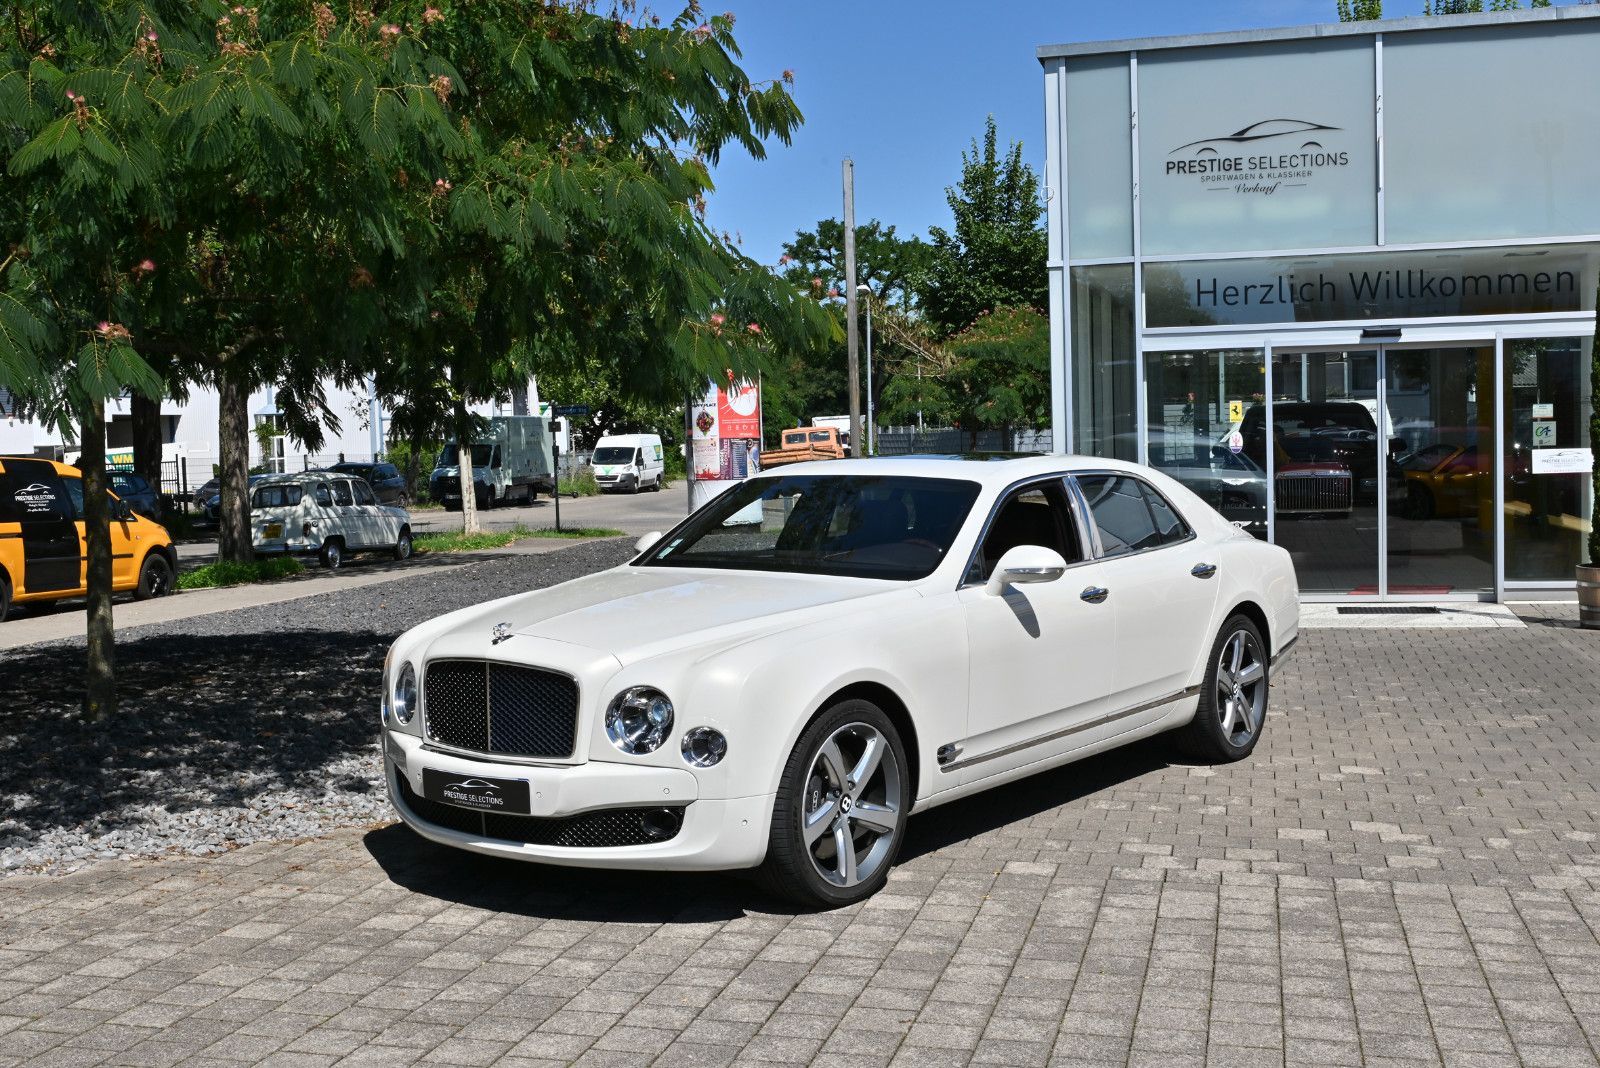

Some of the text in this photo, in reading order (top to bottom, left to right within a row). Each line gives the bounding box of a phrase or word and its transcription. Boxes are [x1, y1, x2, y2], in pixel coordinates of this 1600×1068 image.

[1166, 152, 1349, 175] PRESTIGE SELECTIONS
[1200, 173, 1256, 182] SPORTWAGEN
[1267, 170, 1313, 179] KLASSIKER
[1234, 182, 1281, 195] Verkauf
[1195, 269, 1575, 307] Herzlich Willkommen
[443, 790, 504, 805] PRESTIGE SELECTIONS
